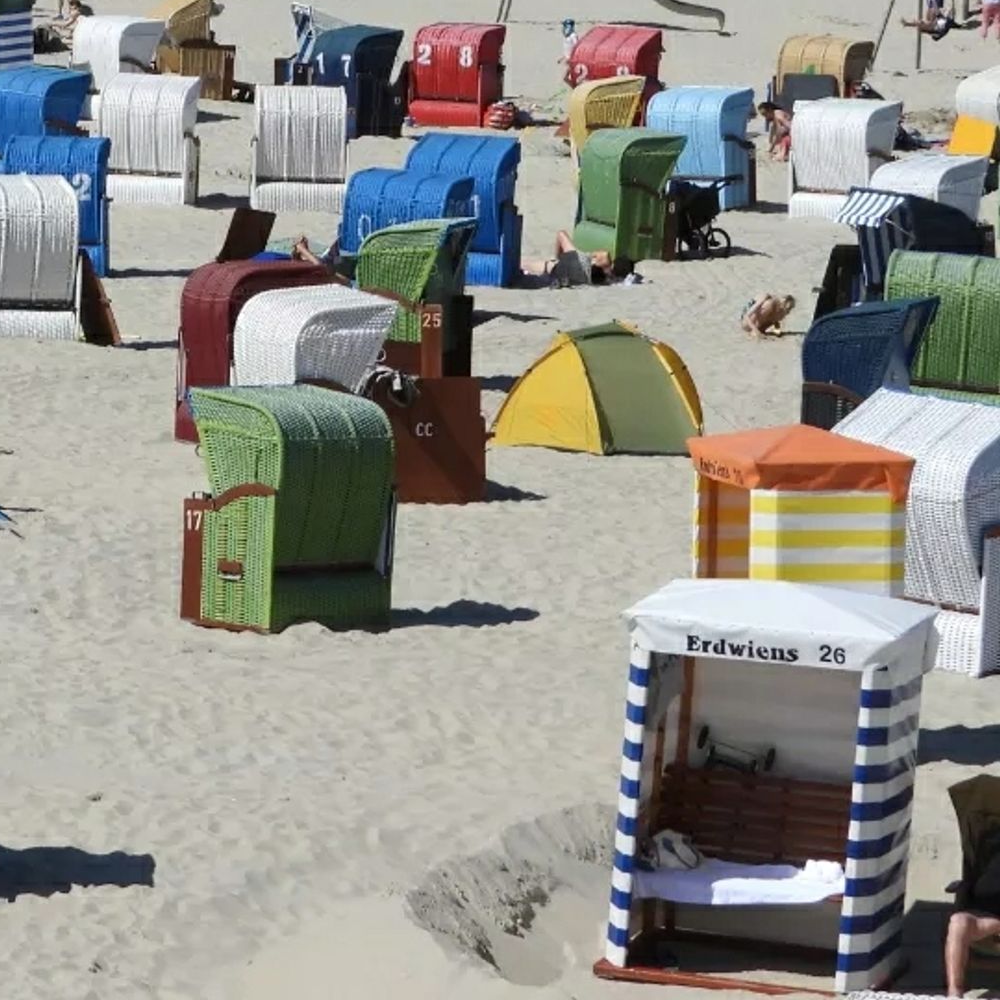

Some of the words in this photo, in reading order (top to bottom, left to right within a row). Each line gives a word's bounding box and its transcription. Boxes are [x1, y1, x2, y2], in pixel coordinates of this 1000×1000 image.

[316, 51, 325, 75] 1
[340, 54, 352, 78] 7
[417, 44, 430, 65] 2
[459, 46, 473, 68] 8
[574, 63, 588, 85] 2
[72, 172, 92, 201] 2
[422, 312, 442, 328] 25
[415, 422, 434, 437] CC
[186, 510, 203, 531] 17
[686, 634, 800, 663] Erdwiens
[819, 643, 847, 665] 26
